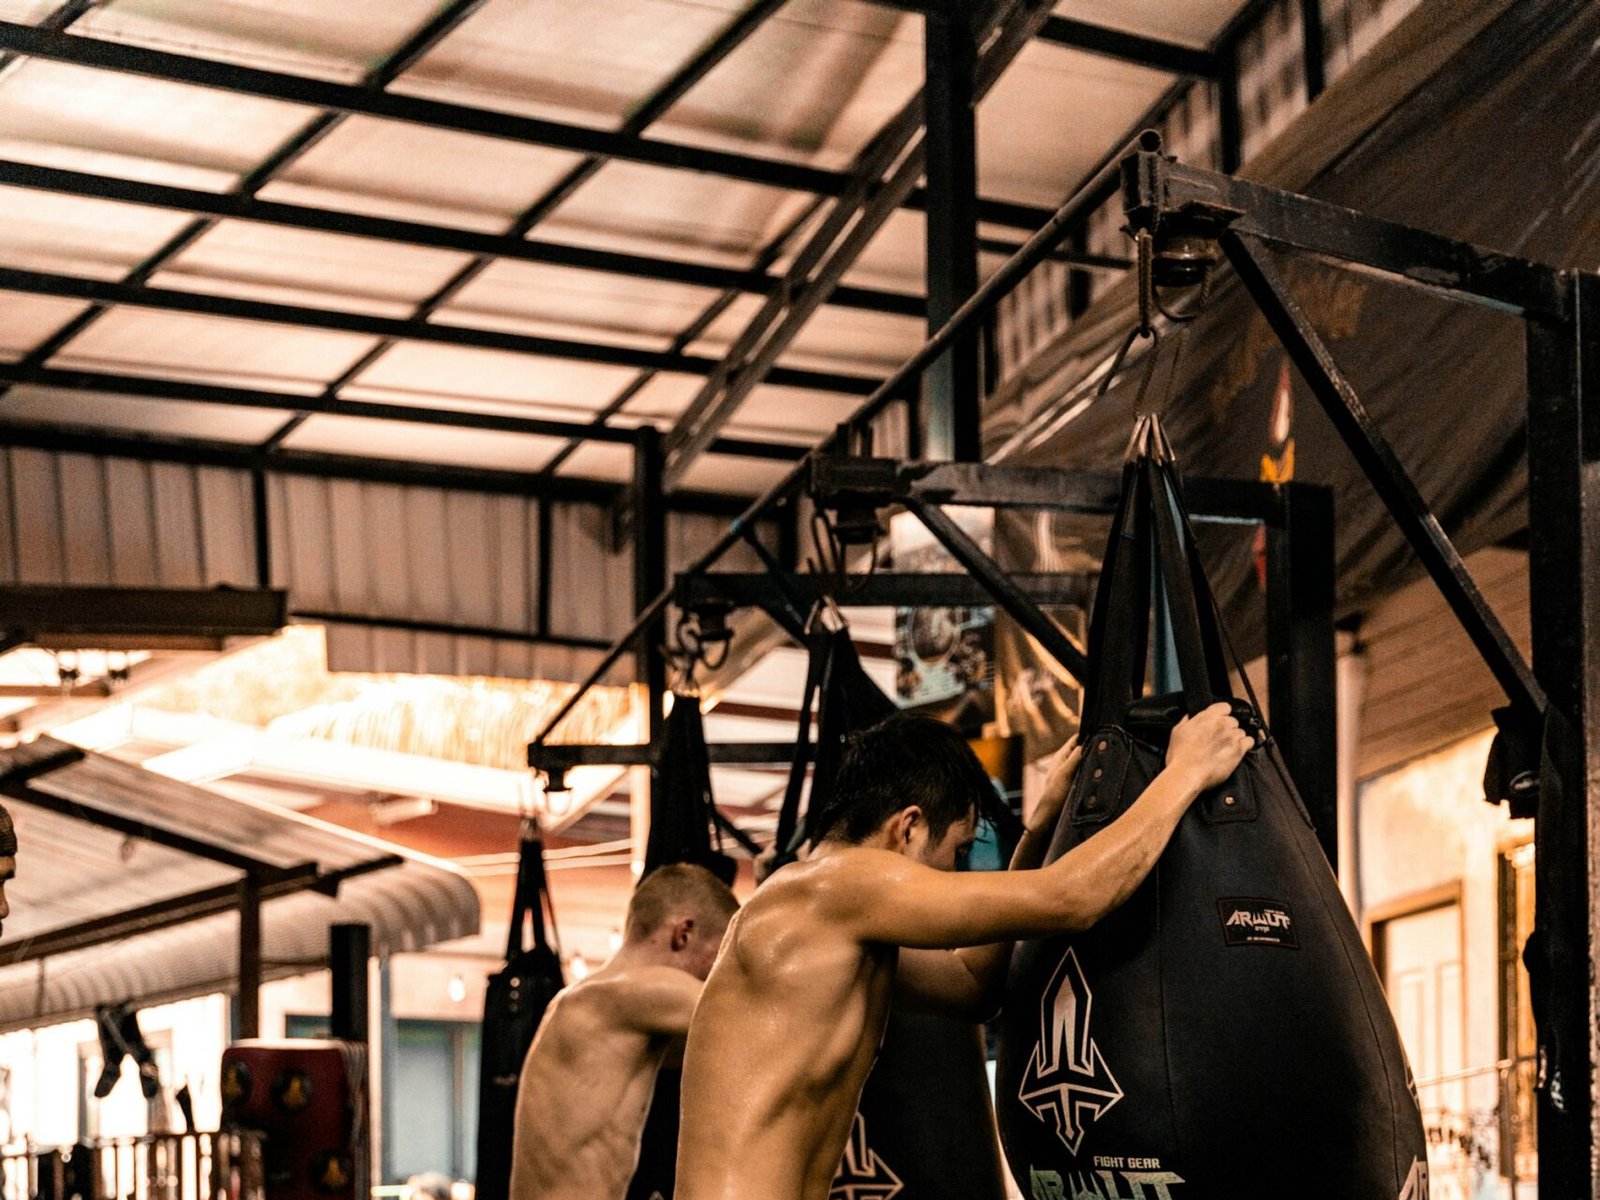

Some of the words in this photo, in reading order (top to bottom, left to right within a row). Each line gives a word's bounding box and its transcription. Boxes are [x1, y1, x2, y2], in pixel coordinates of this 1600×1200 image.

[1225, 909, 1289, 931] ARWUT
[1093, 1155, 1125, 1168] FIGHT
[1127, 1157, 1161, 1169] GEAR
